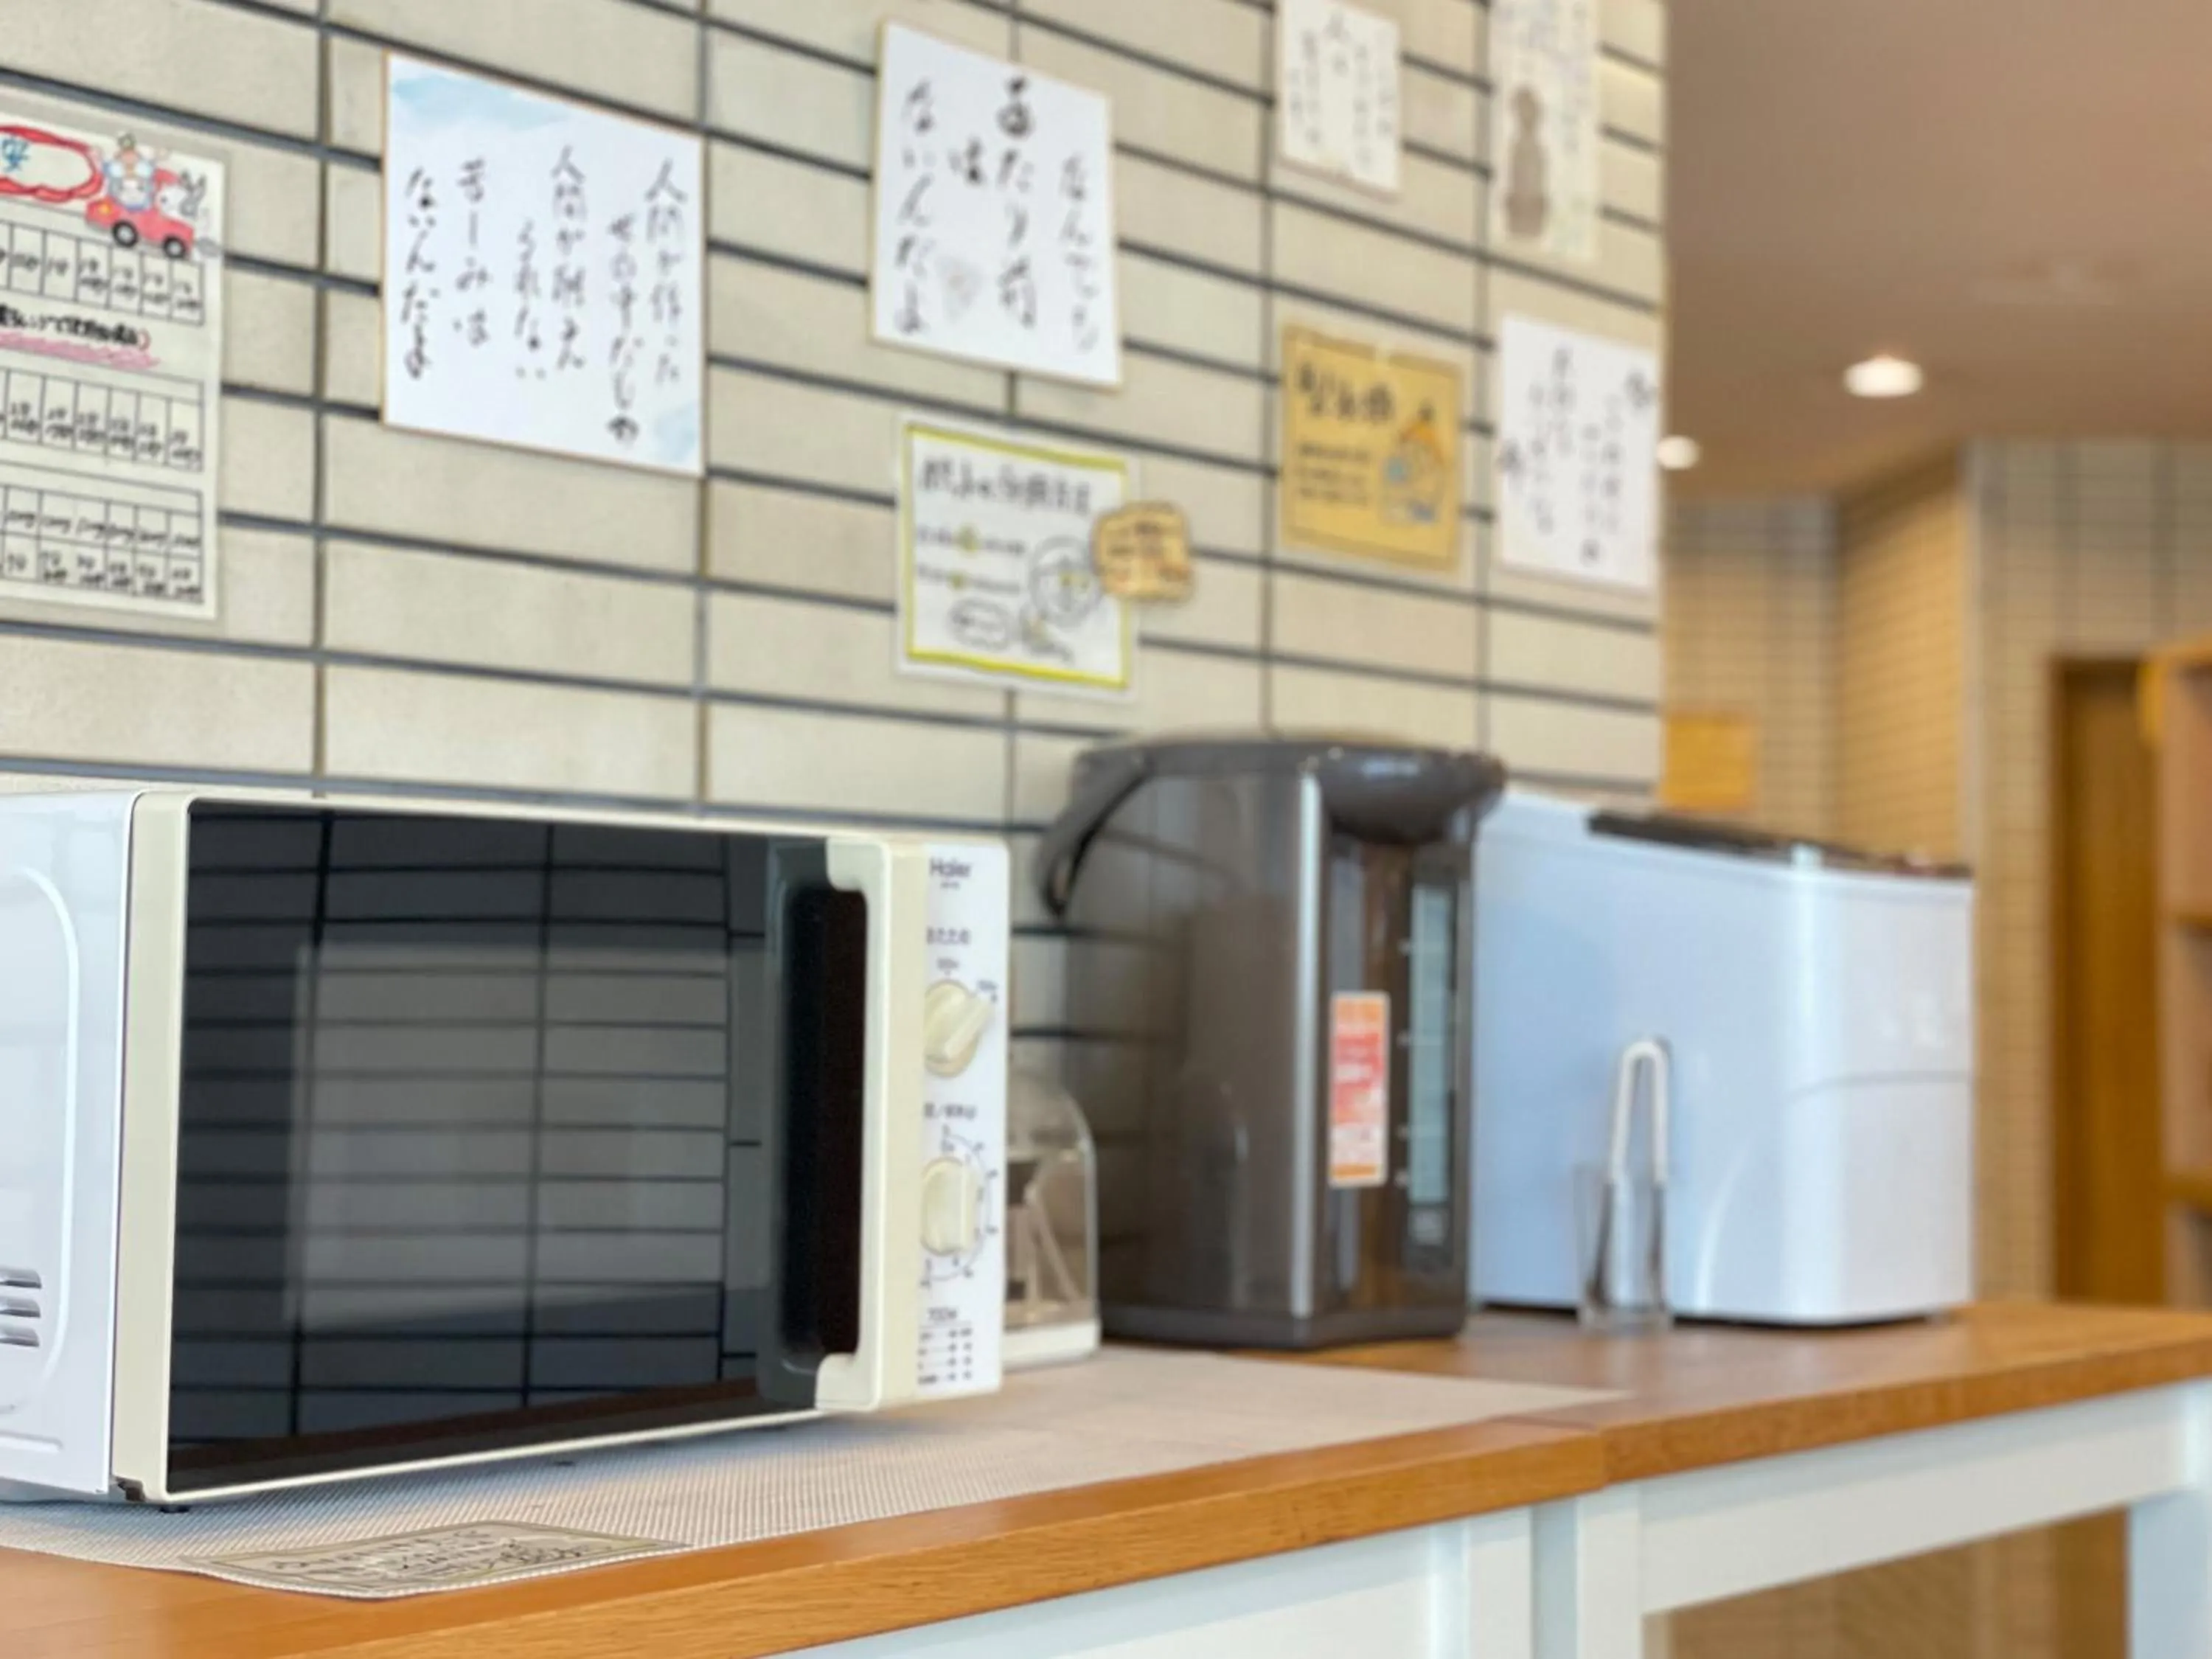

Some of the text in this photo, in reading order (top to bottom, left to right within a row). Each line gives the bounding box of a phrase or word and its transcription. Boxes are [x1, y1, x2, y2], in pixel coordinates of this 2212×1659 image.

[400, 166, 441, 381] ないんだよ
